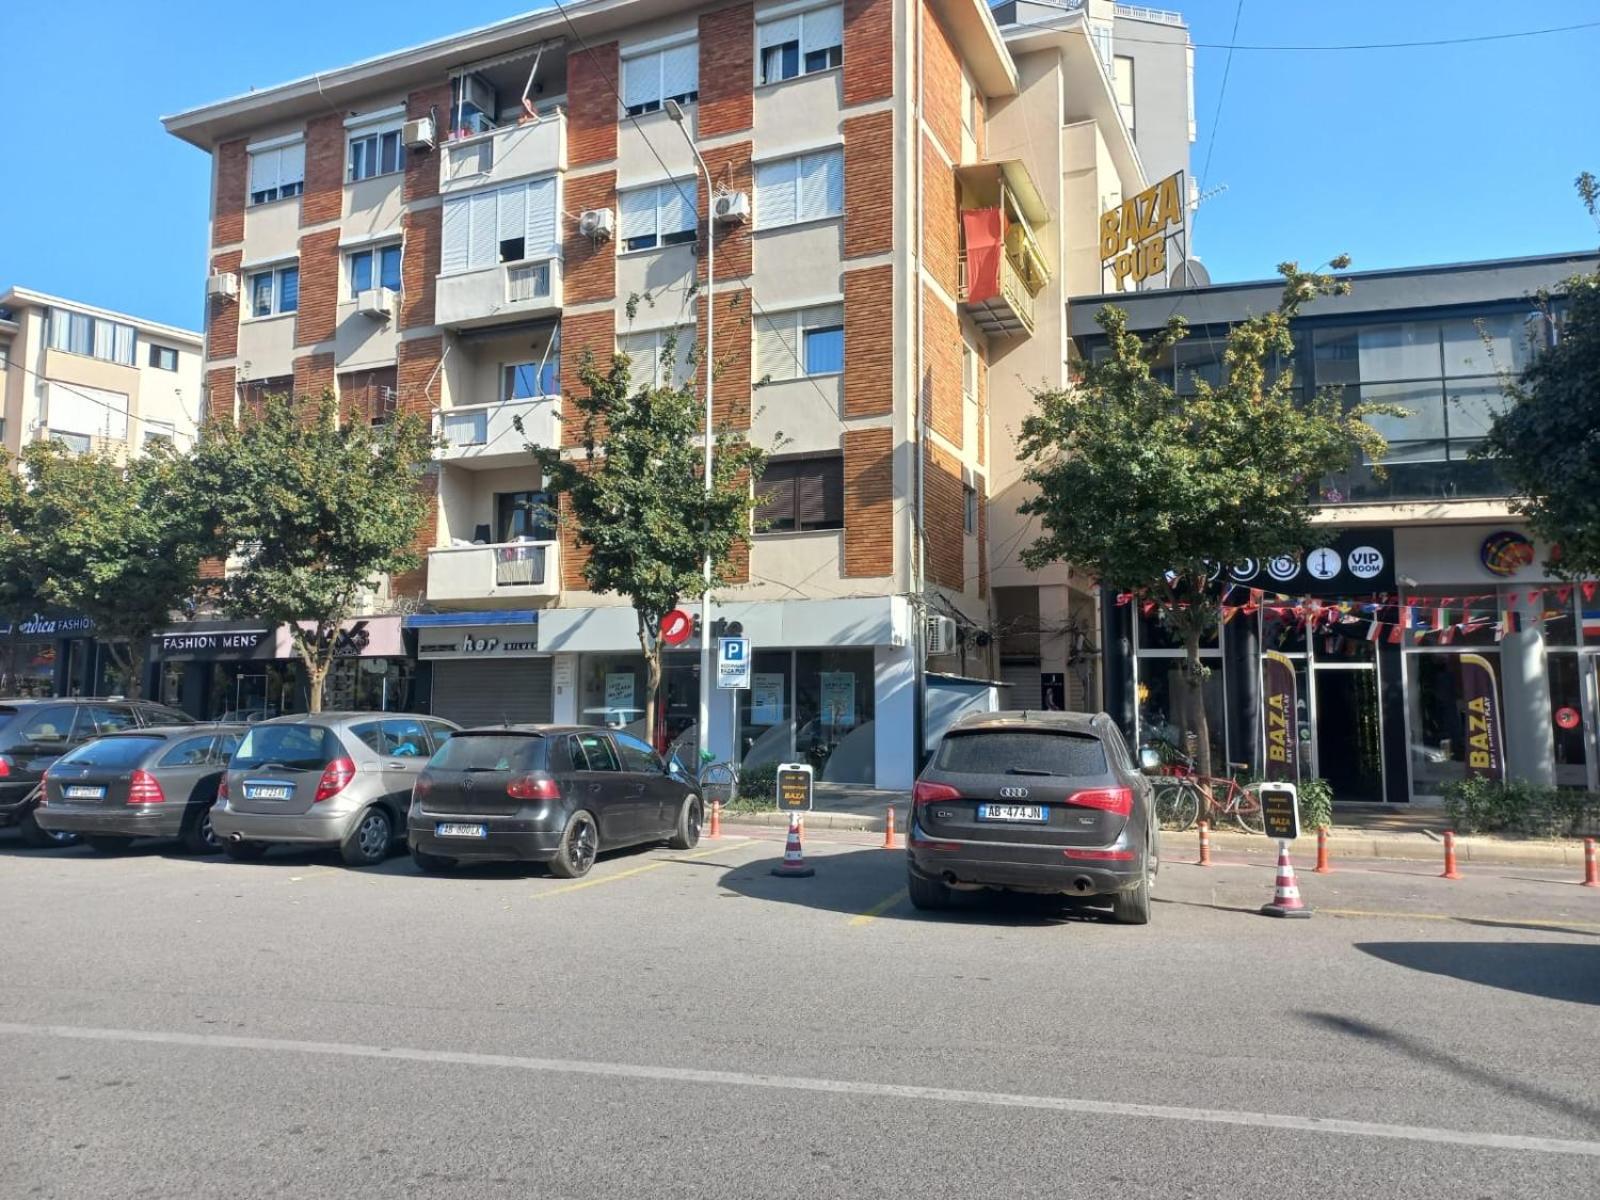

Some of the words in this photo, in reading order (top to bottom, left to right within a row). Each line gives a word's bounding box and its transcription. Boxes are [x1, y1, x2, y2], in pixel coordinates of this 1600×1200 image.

[1101, 175, 1181, 261] BAZA
[1115, 236, 1166, 291] PUB
[1351, 552, 1380, 564] VIP
[1351, 564, 1380, 573] ROOM
[58, 617, 96, 631] FASHION
[163, 636, 217, 649] FASHION
[222, 635, 258, 648] MENS
[728, 643, 739, 659] P
[1483, 696, 1492, 717] PLAY
[1269, 693, 1286, 762] BAZA
[1468, 696, 1490, 768] BAZA
[988, 804, 1001, 817] AB
